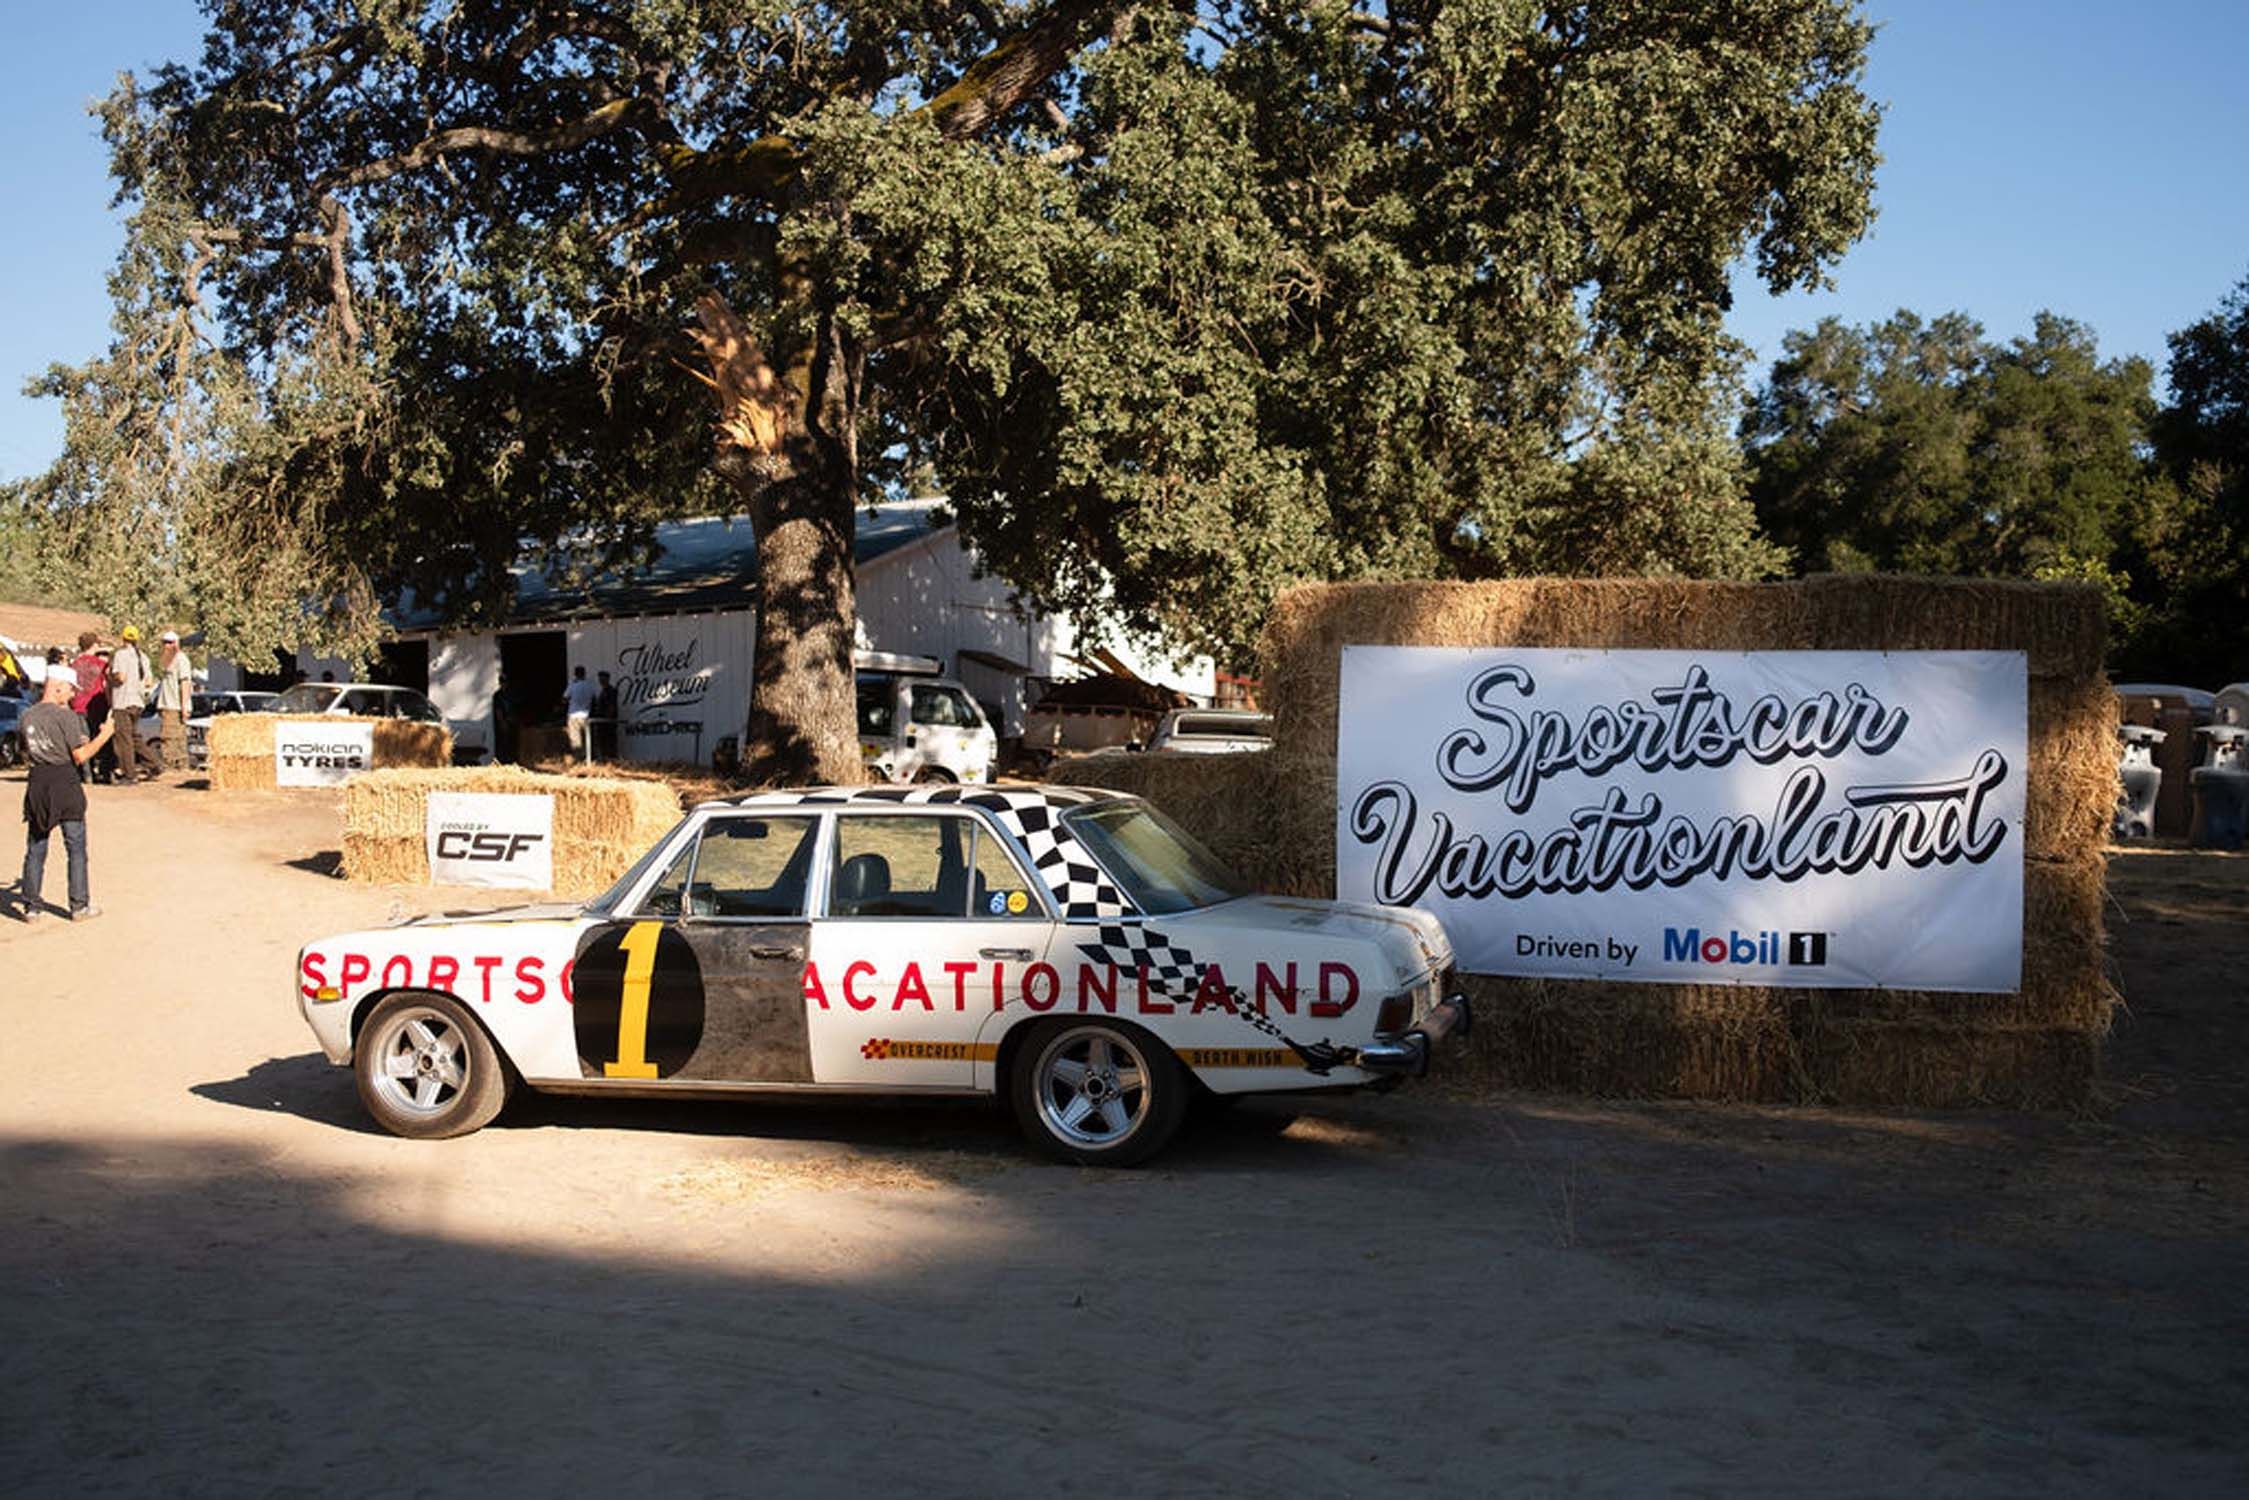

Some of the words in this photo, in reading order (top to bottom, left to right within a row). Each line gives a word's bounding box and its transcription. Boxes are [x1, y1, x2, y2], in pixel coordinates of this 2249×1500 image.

[618, 638, 697, 676] Wheel
[616, 675, 712, 705] Museum
[1436, 664, 1909, 812] Sportscar
[282, 755, 363, 769] TYRES
[1351, 748, 2009, 905] Vacationland
[437, 832, 544, 861] CSF
[1516, 934, 1600, 958] Driven
[1607, 936, 1639, 966] by
[1664, 928, 1779, 965] Mobil
[604, 921, 665, 1079] 1
